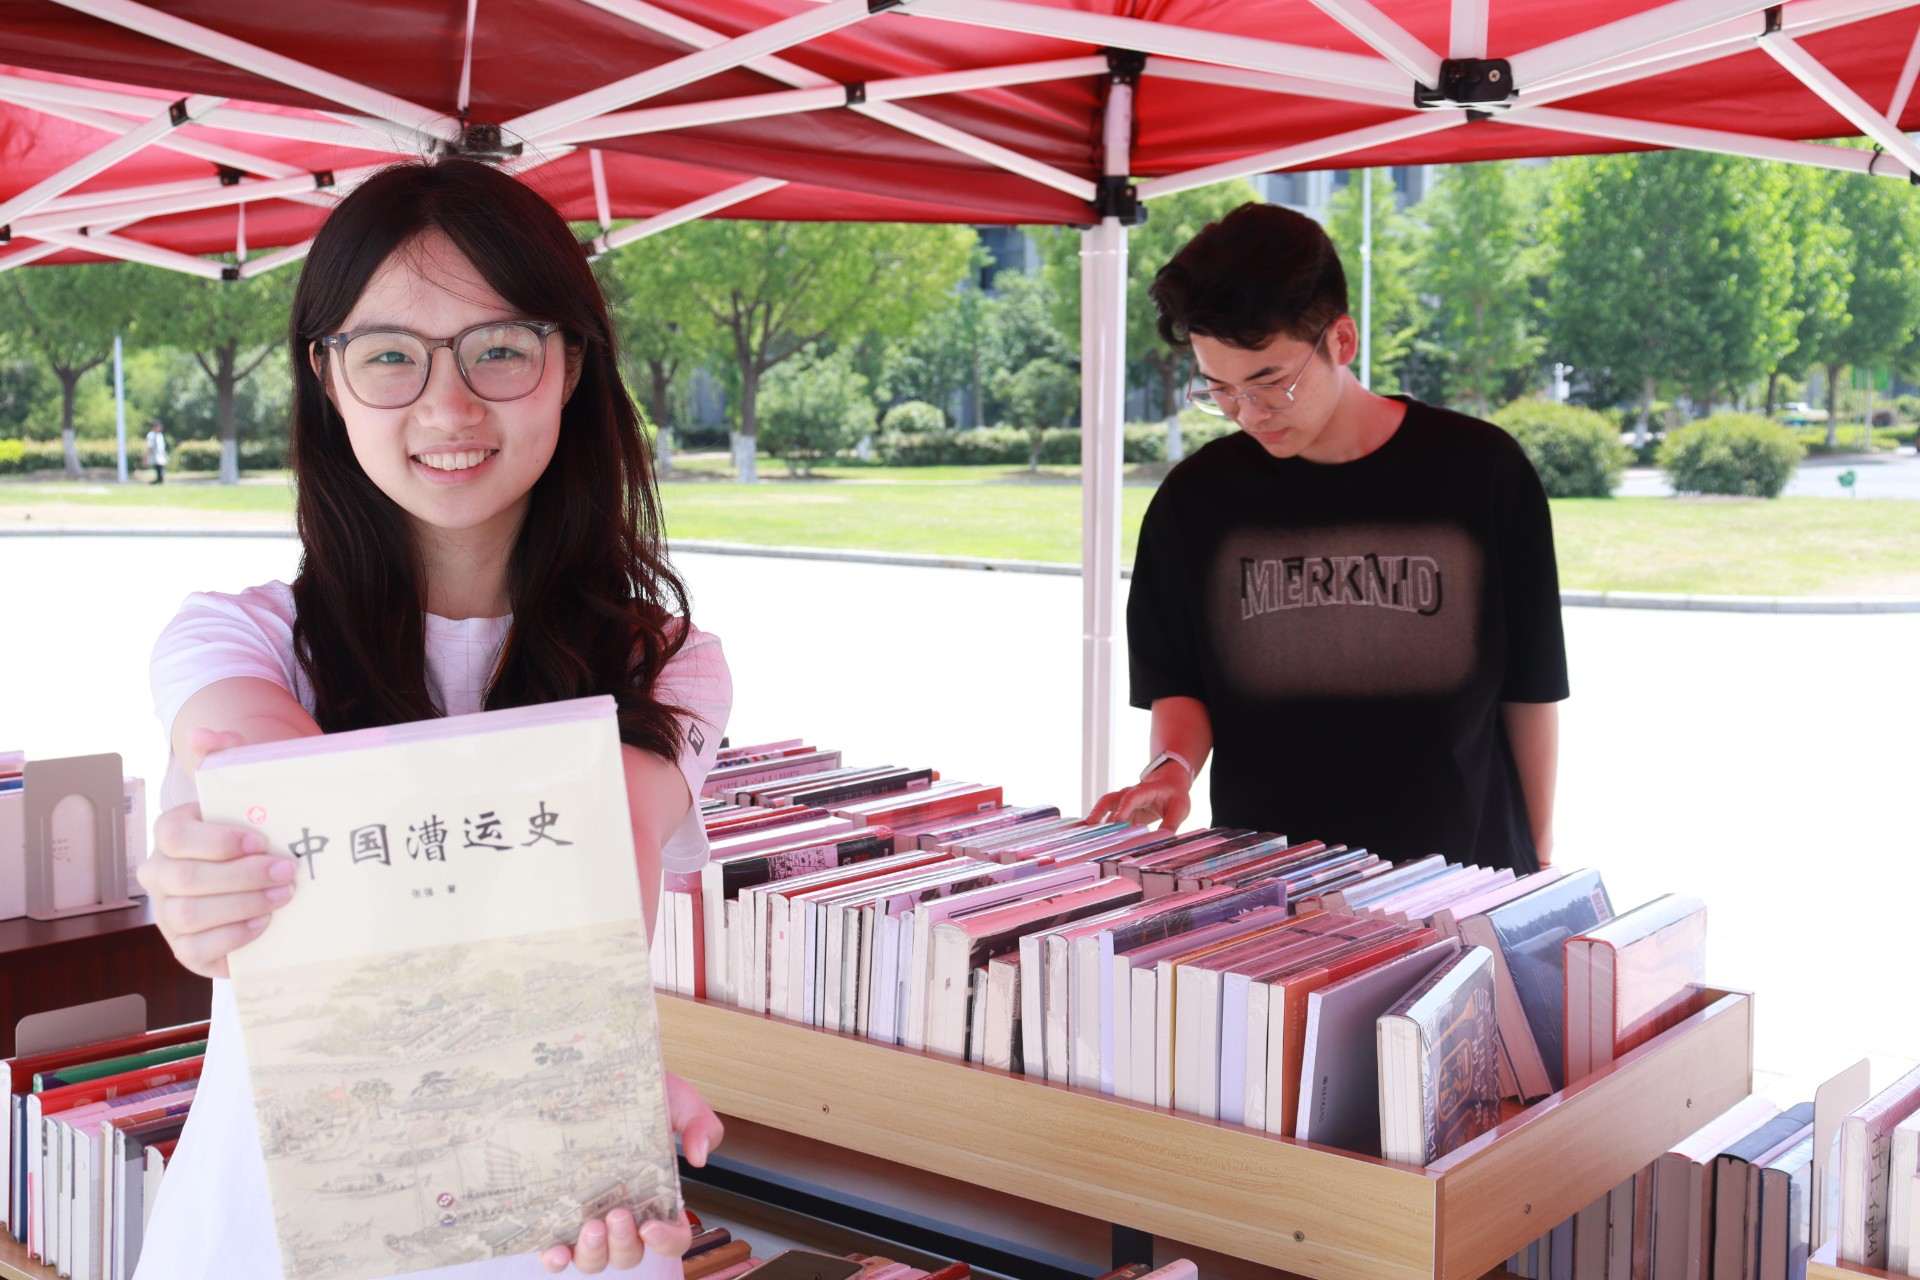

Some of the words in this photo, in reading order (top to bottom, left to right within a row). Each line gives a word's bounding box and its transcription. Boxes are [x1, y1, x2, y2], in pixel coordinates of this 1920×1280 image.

[1240, 553, 1443, 621] MERKNID
[288, 800, 574, 880] 中国漕运史
